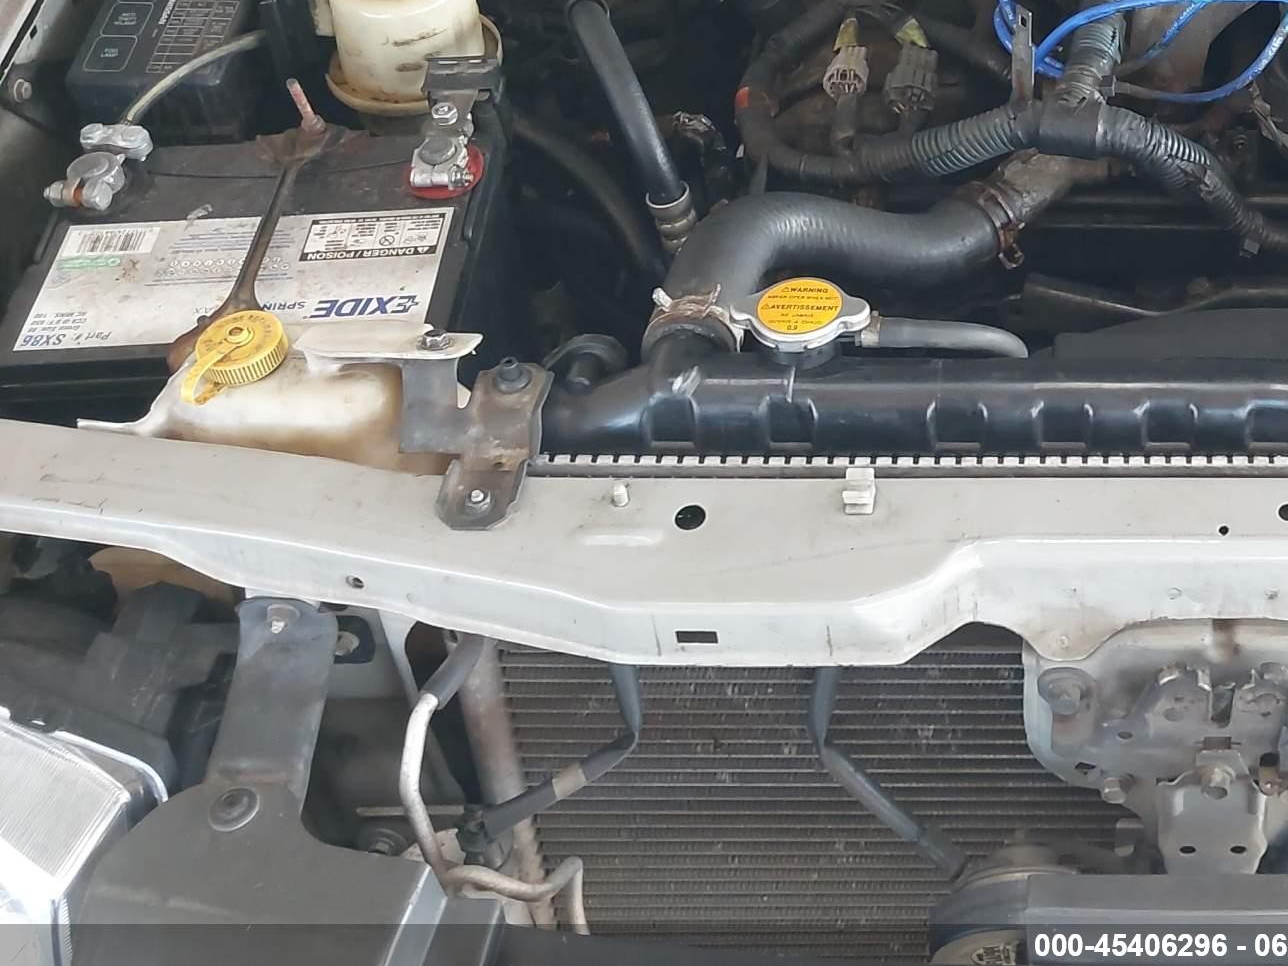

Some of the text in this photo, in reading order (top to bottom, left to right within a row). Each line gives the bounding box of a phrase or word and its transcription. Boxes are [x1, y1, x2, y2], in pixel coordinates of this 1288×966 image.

[307, 250, 356, 261] POISON
[363, 247, 416, 258] DANGER
[262, 300, 307, 311] SPRIN
[309, 295, 419, 319] EXIDE
[20, 334, 66, 347] SX86
[85, 331, 112, 341] Part
